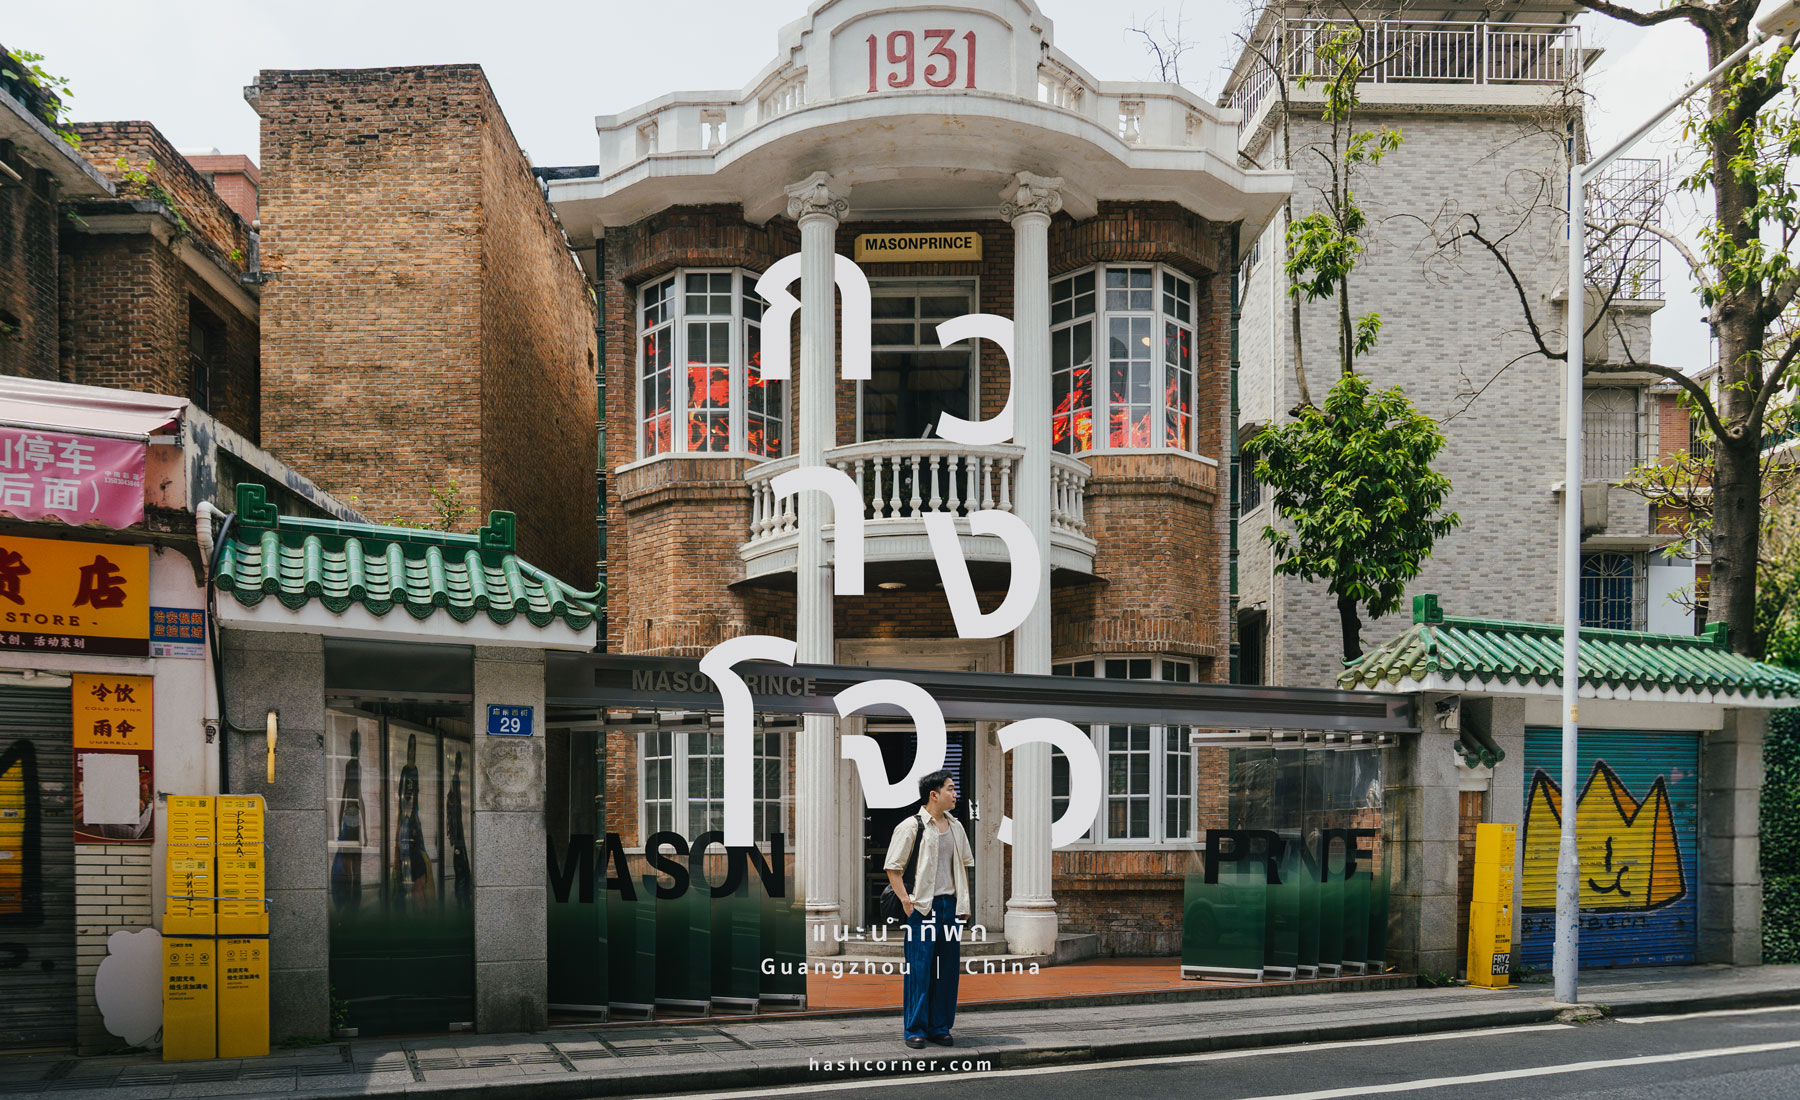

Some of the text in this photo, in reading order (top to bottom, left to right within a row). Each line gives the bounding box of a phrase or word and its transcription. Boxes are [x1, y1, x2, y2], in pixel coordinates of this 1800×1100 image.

[866, 29, 977, 93] 1931
[865, 236, 973, 250] MASONPRINCE
[5, 612, 80, 627] STORE
[153, 610, 203, 625] 治安视频
[153, 624, 203, 639] 监控区域
[91, 683, 136, 704] 冷饮
[93, 719, 136, 739] 雨伞
[500, 717, 520, 733] 29
[546, 831, 786, 904] MASON
